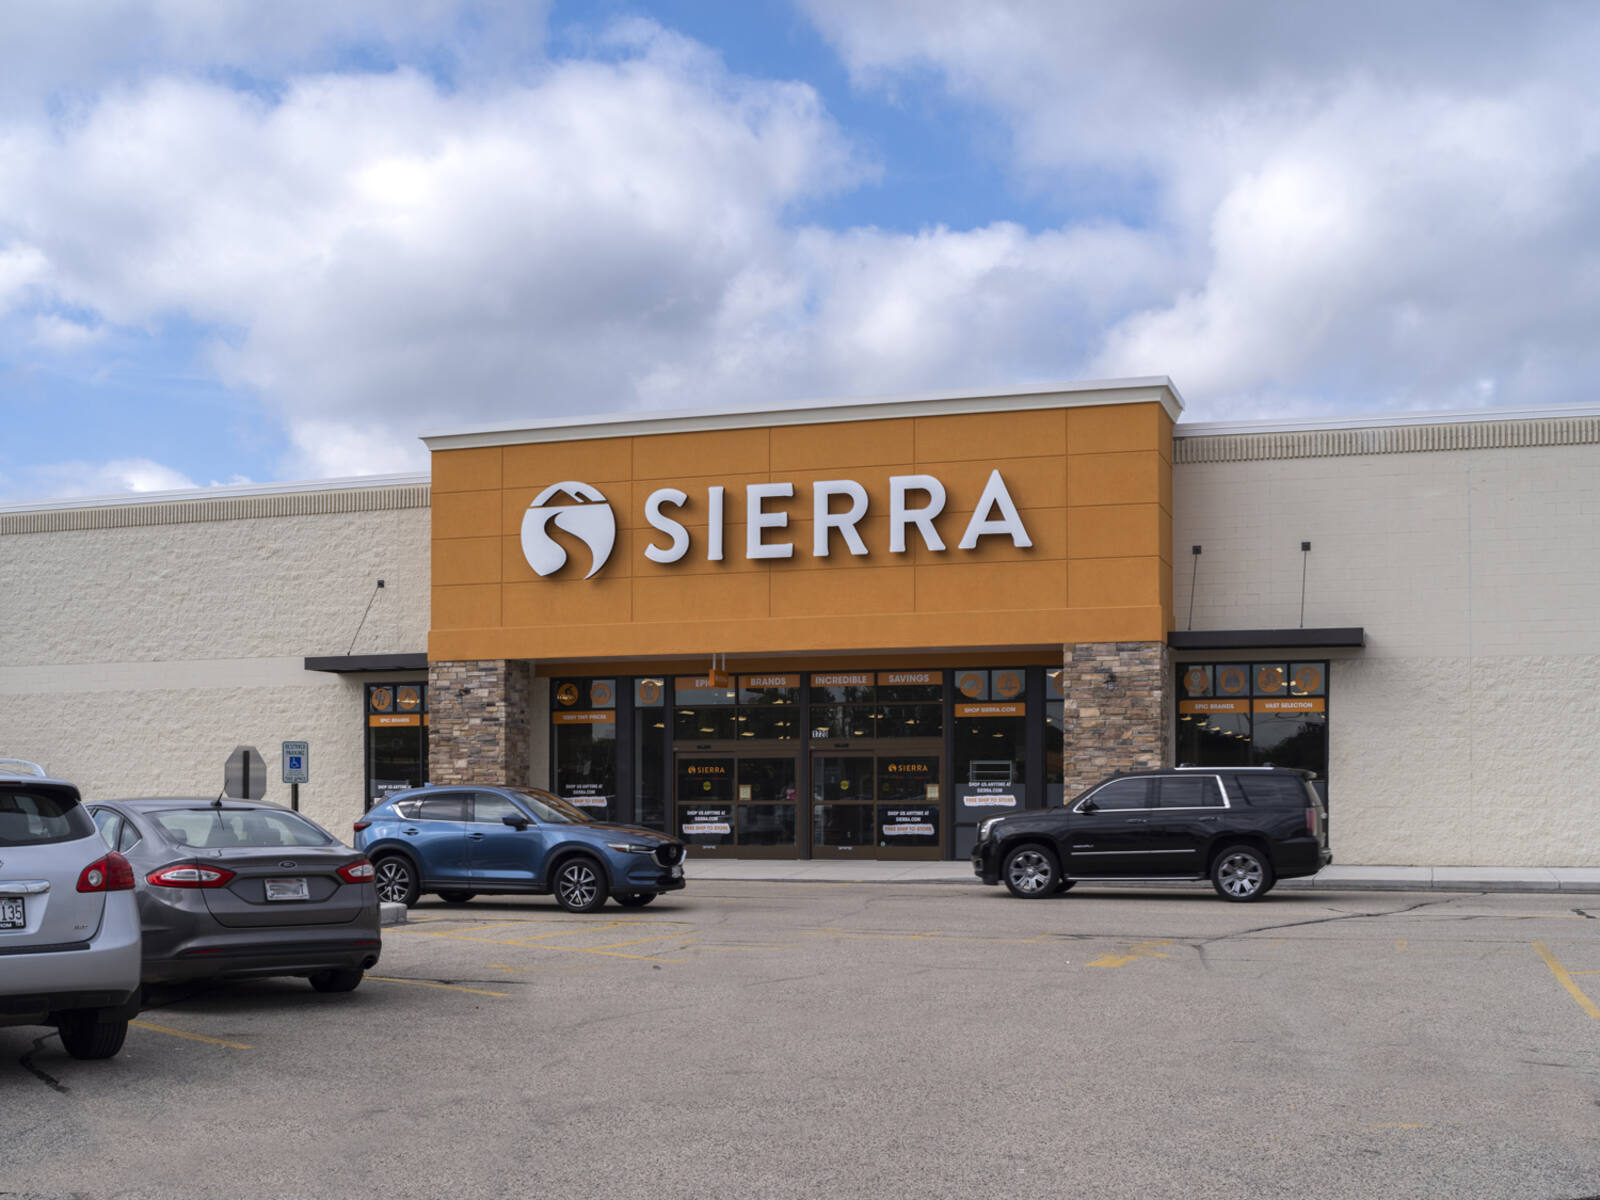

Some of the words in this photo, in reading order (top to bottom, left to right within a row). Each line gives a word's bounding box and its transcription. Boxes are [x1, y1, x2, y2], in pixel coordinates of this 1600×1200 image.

[644, 469, 1033, 563] SIERRA
[750, 677, 786, 686] BRANDS
[815, 675, 867, 685] INCREDIBLE
[888, 673, 930, 683] SAVINGS
[1281, 701, 1313, 709] SELECTION
[697, 766, 725, 774] SIERRA
[897, 764, 928, 773] SIERRA
